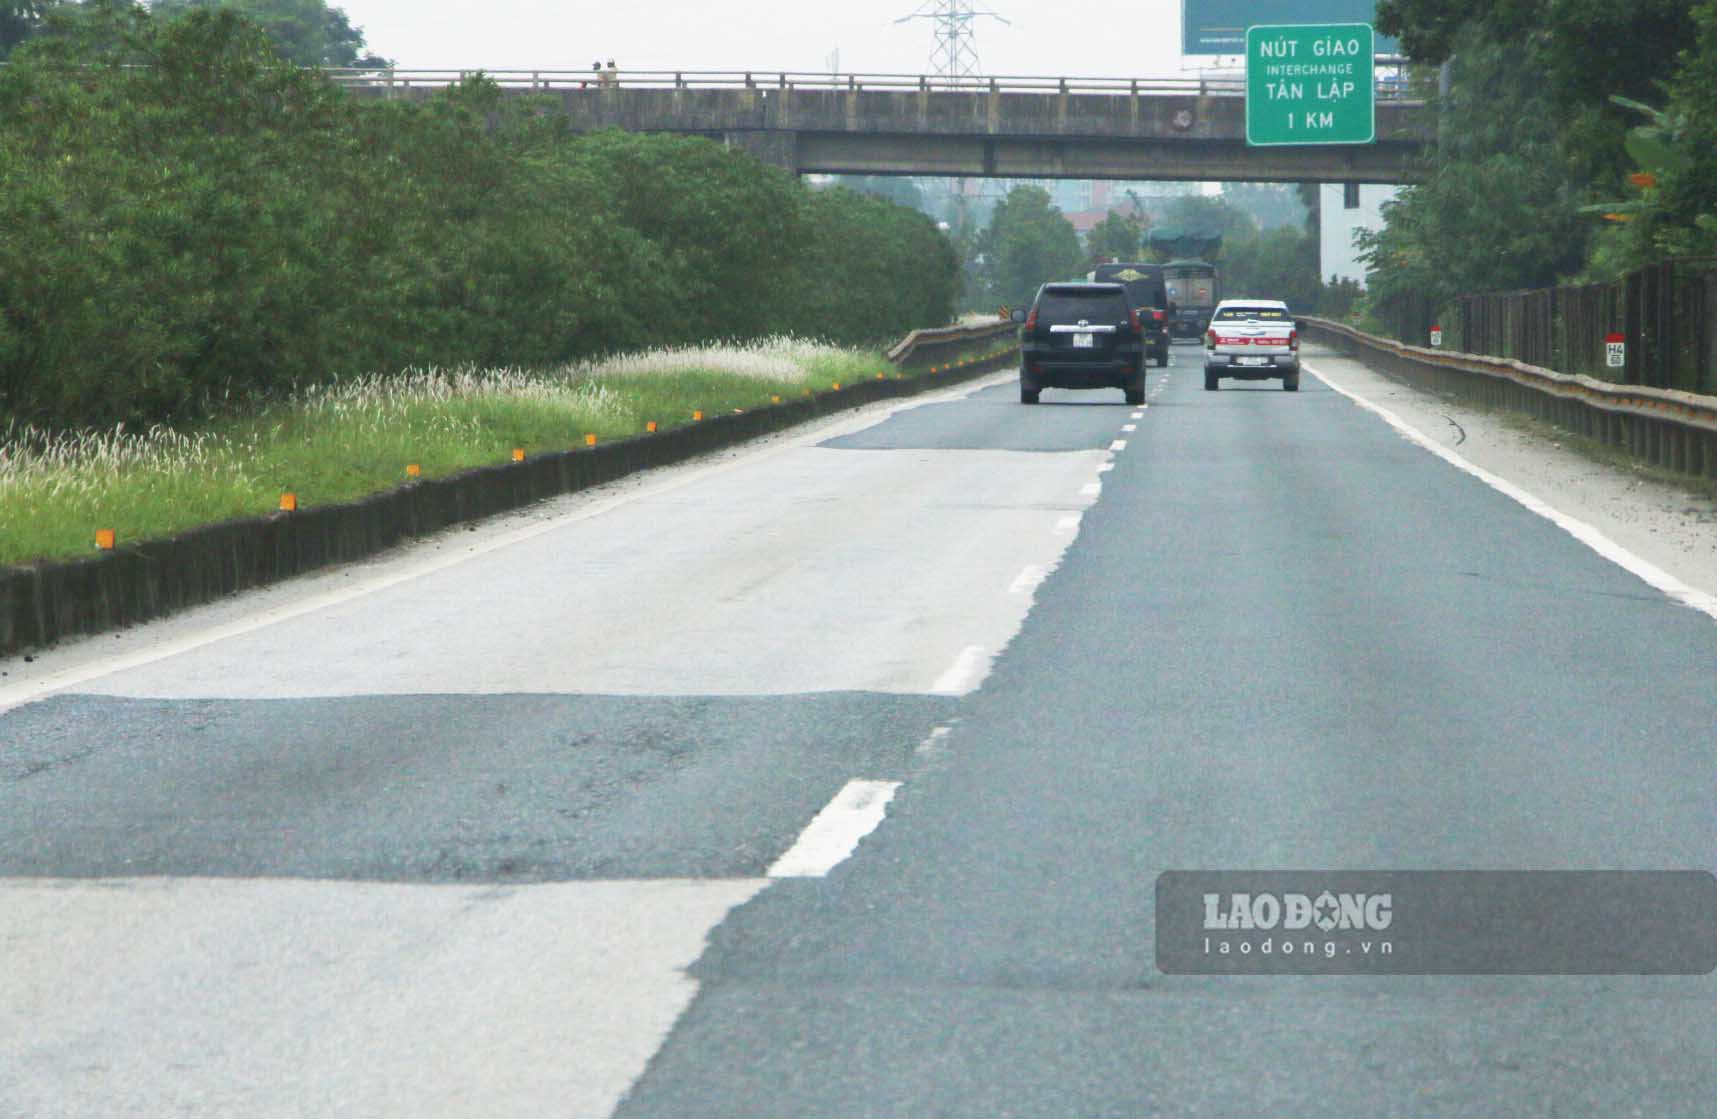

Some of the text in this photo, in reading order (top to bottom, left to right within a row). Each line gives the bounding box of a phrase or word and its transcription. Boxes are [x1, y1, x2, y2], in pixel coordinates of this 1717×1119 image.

[1260, 35, 1298, 57] NÚT
[1267, 64, 1353, 76] INTERCHANGE
[1288, 112, 1333, 129] 1 KM
